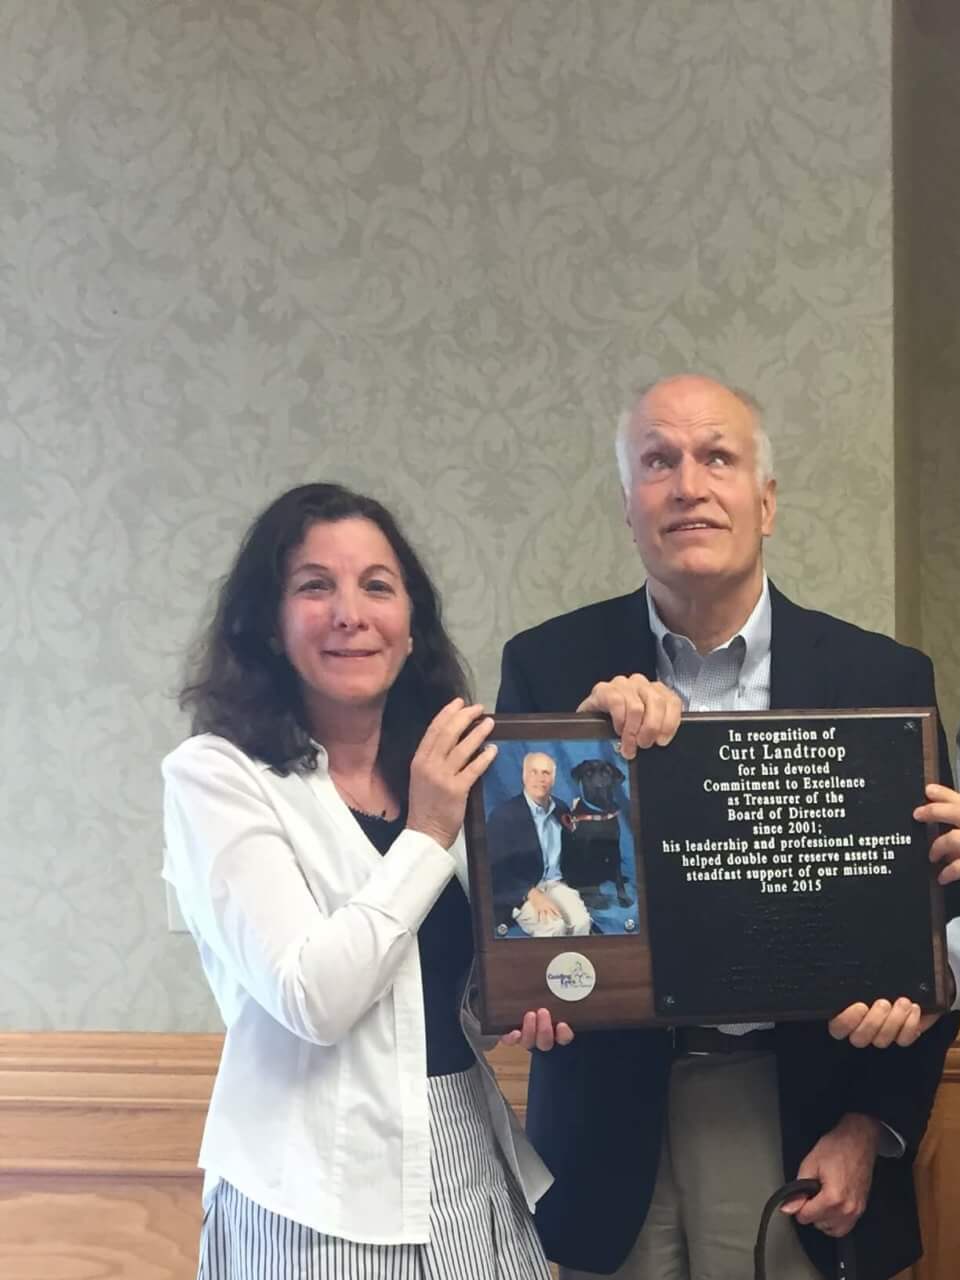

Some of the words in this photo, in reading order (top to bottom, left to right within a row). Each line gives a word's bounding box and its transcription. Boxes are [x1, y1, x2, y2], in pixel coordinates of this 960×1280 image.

[728, 729, 742, 742] In
[747, 728, 817, 743] recognition
[822, 727, 836, 740] of
[719, 745, 756, 760] Curt
[762, 742, 846, 761] Landtroop
[738, 763, 756, 776] for
[761, 763, 779, 776] his
[784, 762, 830, 775] devoted
[703, 779, 780, 792] Commitment
[785, 779, 798, 790] to
[803, 776, 865, 789] Excellence
[727, 796, 740, 806] as
[743, 793, 800, 806] Treasurer
[805, 791, 819, 804] of
[825, 791, 844, 804] the
[728, 807, 764, 821] Board
[769, 807, 783, 820] of
[788, 806, 846, 819] Directors
[753, 822, 783, 835] since
[788, 821, 822, 836] 2001;
[662, 840, 681, 852] his
[685, 838, 749, 854] leadership
[753, 837, 775, 850] and
[780, 834, 854, 853] professional
[858, 833, 911, 848] expertise
[682, 853, 722, 868] helped
[727, 851, 767, 865] double
[772, 854, 793, 864] our
[798, 852, 840, 863] reserve
[844, 850, 878, 861] assets
[883, 848, 895, 860] in
[686, 867, 742, 881] steadfast
[746, 867, 794, 882] support
[798, 864, 812, 877] of
[817, 867, 838, 877] our
[843, 863, 892, 876] mission.
[761, 880, 787, 893] June
[793, 879, 822, 892] 2015
